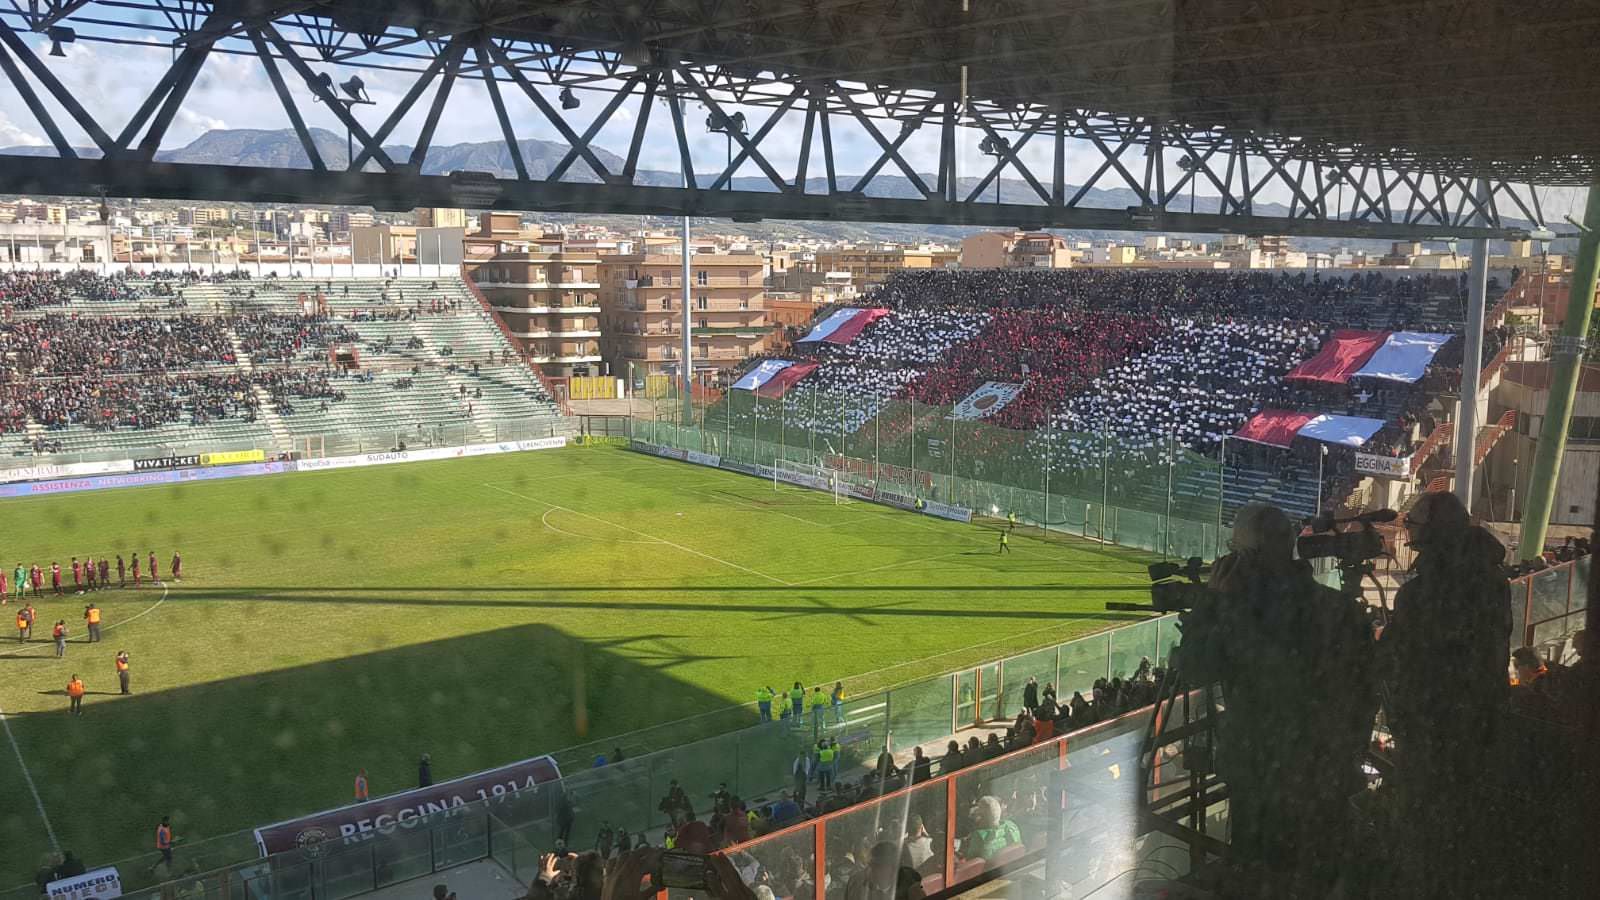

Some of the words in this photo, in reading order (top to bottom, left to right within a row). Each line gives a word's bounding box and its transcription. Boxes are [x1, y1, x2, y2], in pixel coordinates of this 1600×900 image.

[135, 456, 198, 468] VIVATICKET
[367, 452, 408, 462] SUDAUTO
[32, 480, 91, 491] ASSISTENZA
[340, 796, 471, 845] REGGINA
[476, 776, 539, 807] 1914
[51, 874, 116, 896] NUMERO
